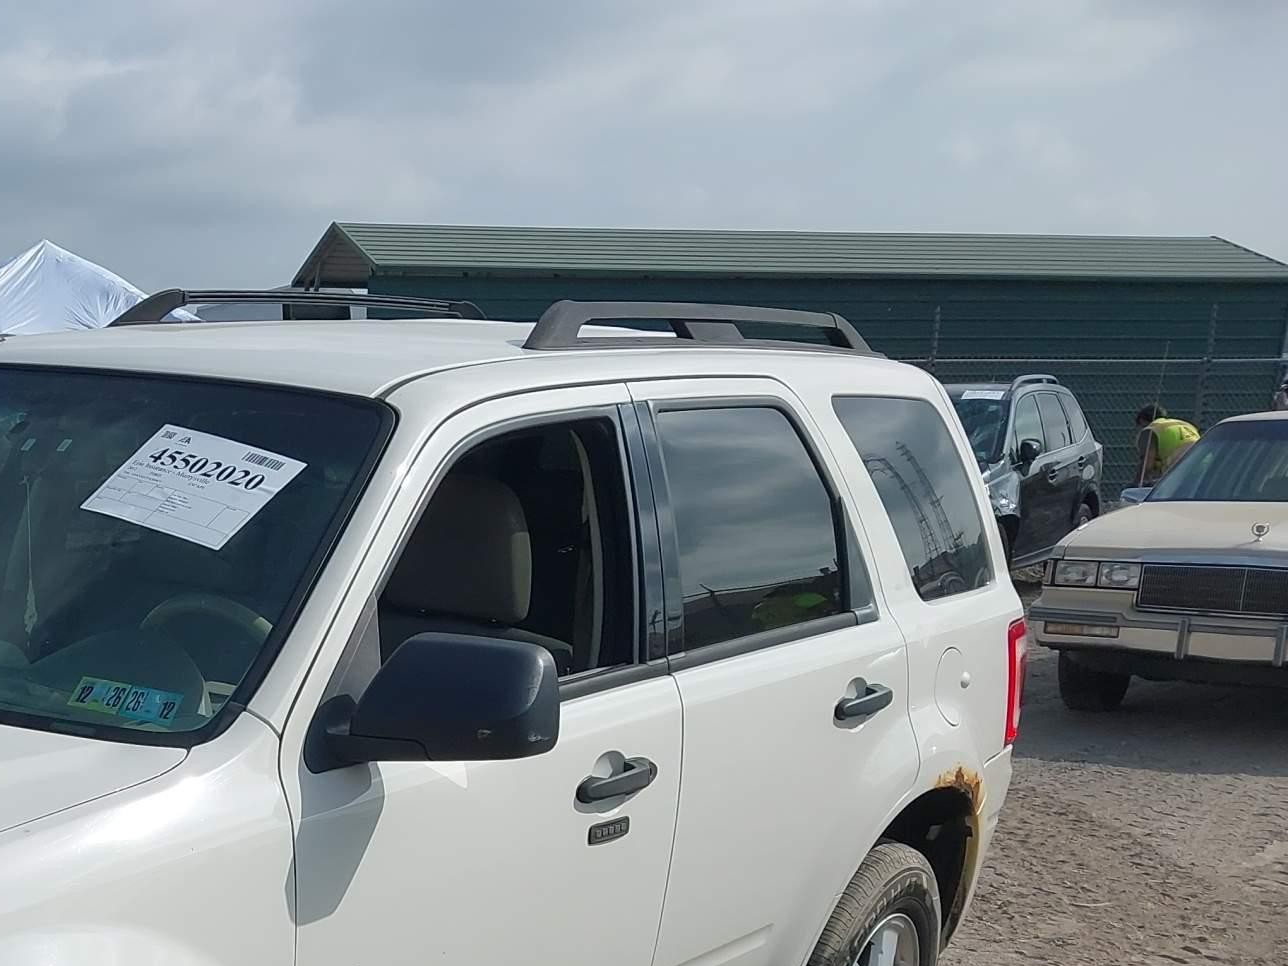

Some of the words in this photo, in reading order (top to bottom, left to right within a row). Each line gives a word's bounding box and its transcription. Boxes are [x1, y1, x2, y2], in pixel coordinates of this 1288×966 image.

[149, 447, 265, 490] 45502020
[76, 685, 94, 703] 12
[105, 687, 127, 707] 26
[126, 691, 145, 712] 26
[159, 701, 176, 719] 12
